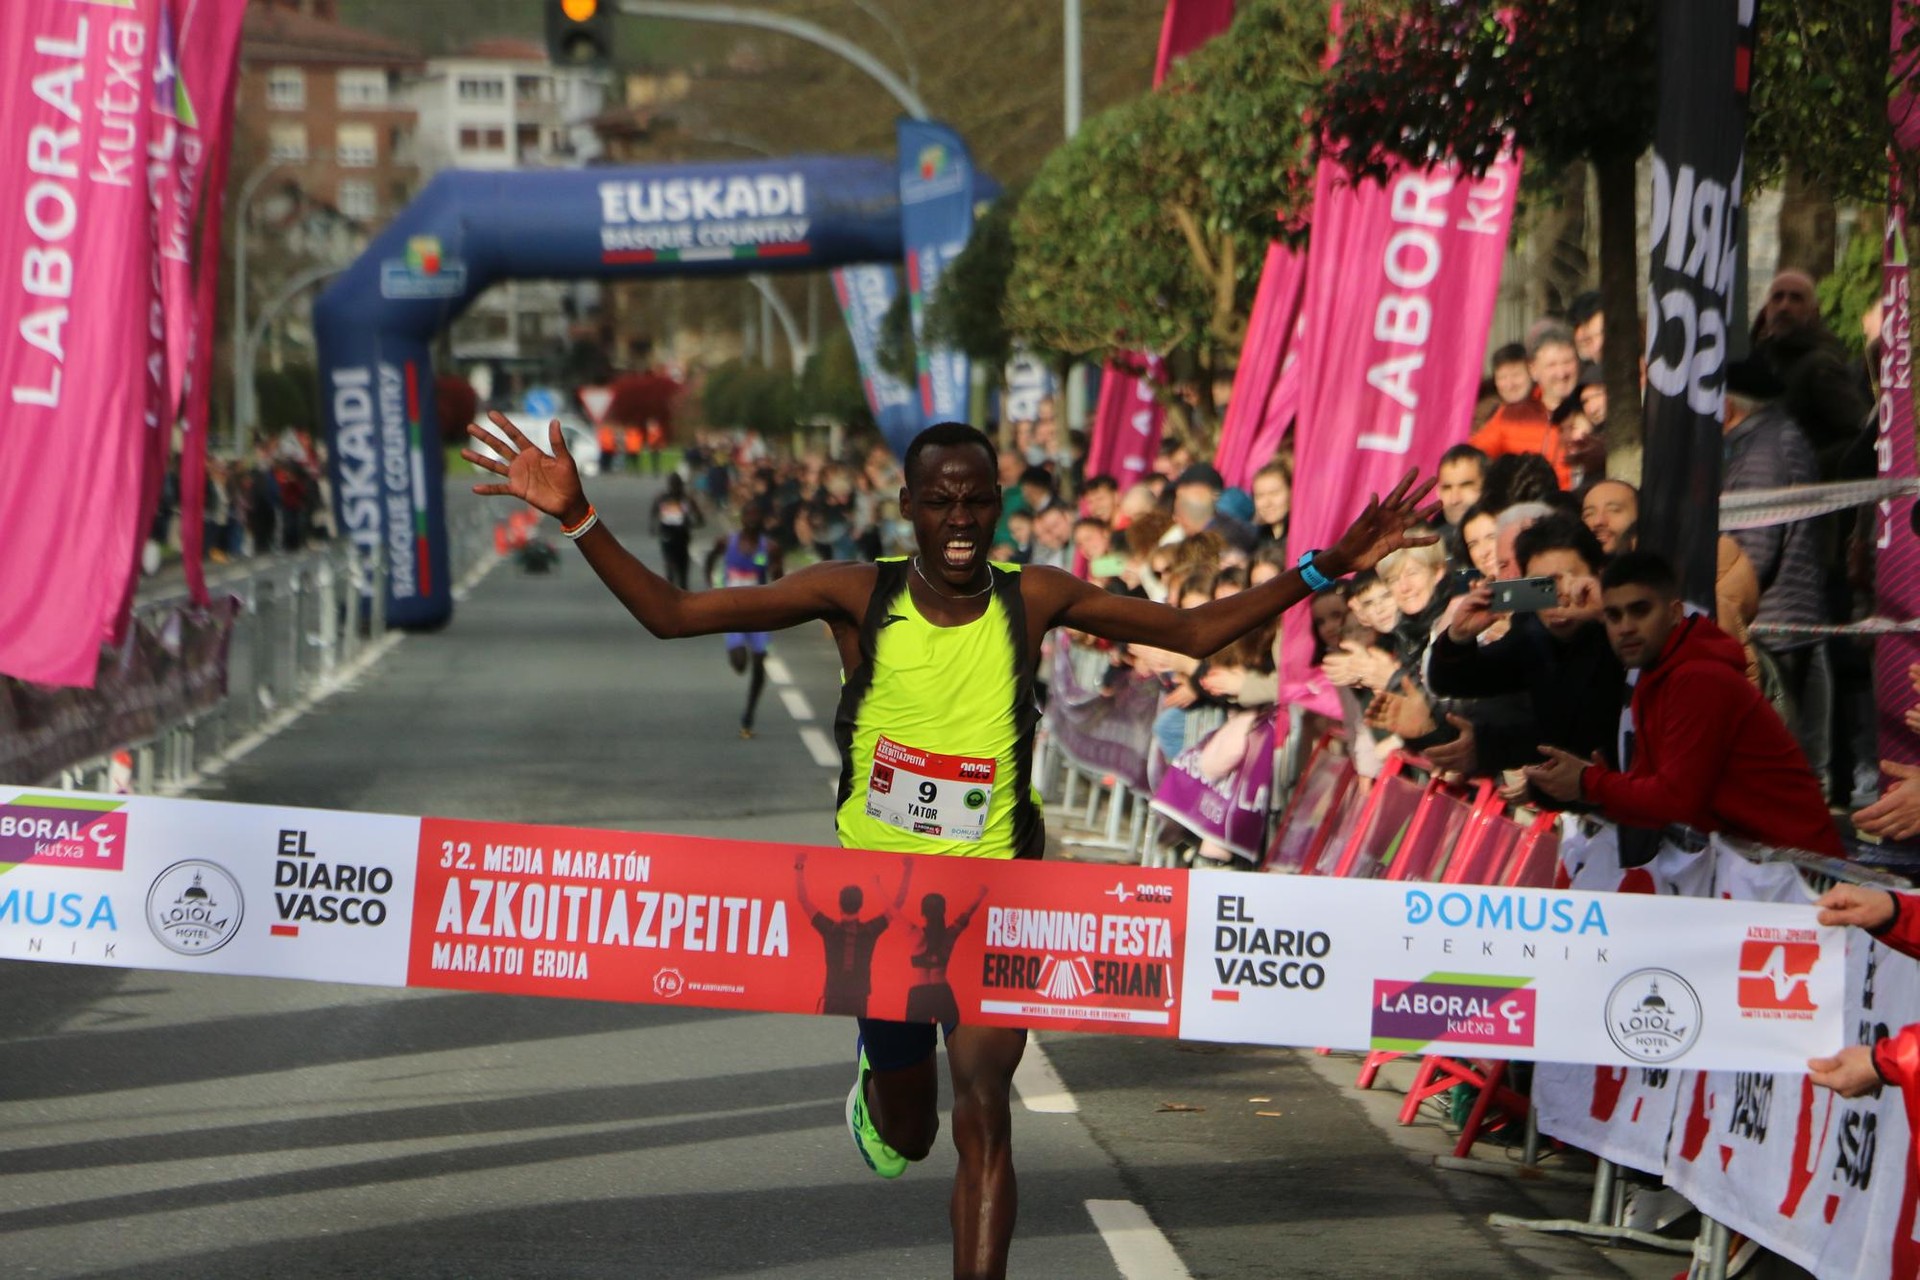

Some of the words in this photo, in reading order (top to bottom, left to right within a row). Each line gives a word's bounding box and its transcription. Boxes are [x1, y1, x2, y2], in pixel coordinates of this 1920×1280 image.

[89, 20, 146, 187] kutxa
[12, 15, 89, 409] LABORAL
[600, 173, 806, 224] EUSKADI
[601, 223, 693, 250] BASQUE
[696, 217, 811, 248] COUNTRY
[1357, 172, 1456, 456] LABOR
[378, 362, 409, 492] COUNTRY
[332, 366, 382, 598] USKADI
[959, 762, 992, 780] 2025
[918, 781, 937, 803] 9
[908, 803, 938, 820] YATOR
[34, 839, 85, 859] kutxa
[278, 829, 316, 858] EL
[274, 860, 393, 895] DIARIO
[439, 840, 476, 870] 32.
[483, 844, 543, 875] MEDIA
[552, 848, 651, 883] MARATÓN
[274, 892, 388, 926] VASCO
[1136, 884, 1173, 904] 2025
[1216, 895, 1254, 924] EL
[162, 906, 228, 930] LOIOLA
[435, 876, 789, 957] AZKOITIAZPEITIA
[1404, 890, 1609, 937] DOMUSA
[175, 928, 211, 940] HOTEL
[986, 906, 1097, 953] RUNNING
[1100, 914, 1173, 958] FESTA
[1214, 927, 1331, 959] DIARIO
[431, 941, 523, 976] MARATOI
[532, 949, 588, 980] ERDIA
[1402, 936, 1610, 964] TEKNIK
[1215, 957, 1325, 990] VASCO
[1381, 991, 1494, 1019] LABORAL
[1446, 1016, 1495, 1036] kutxa
[1619, 1016, 1686, 1038] LOIOLA
[1635, 1037, 1669, 1047] HOTEL
